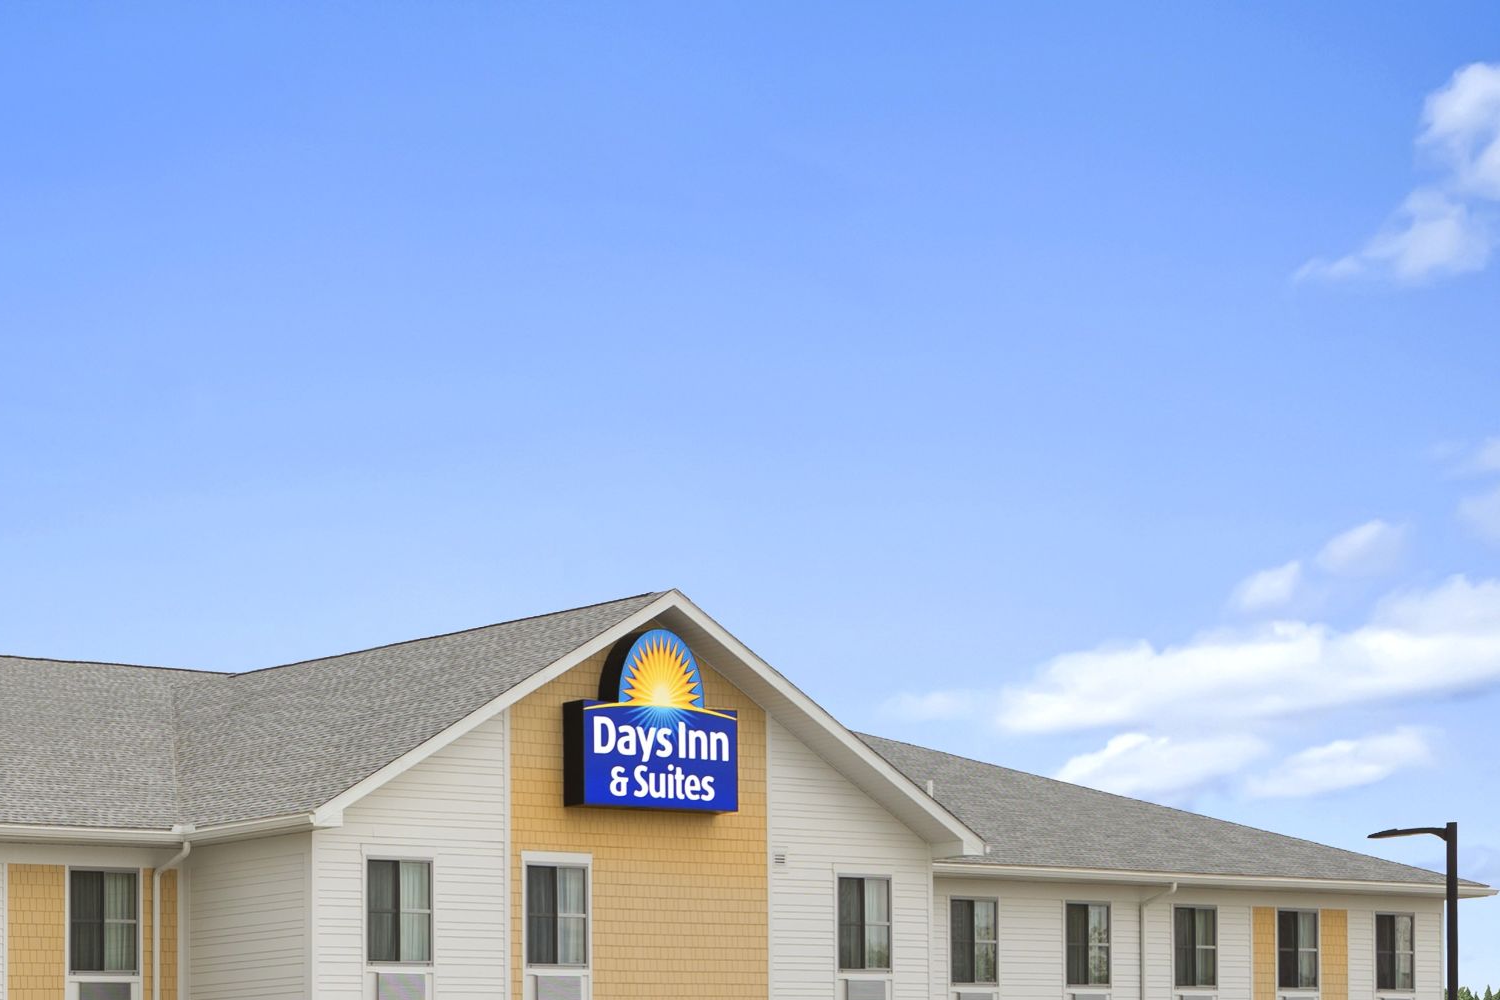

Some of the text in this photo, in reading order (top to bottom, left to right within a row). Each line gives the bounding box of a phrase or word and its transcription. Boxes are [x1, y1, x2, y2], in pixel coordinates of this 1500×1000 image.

[593, 716, 730, 762] Days Inn
[609, 764, 716, 802] & Suites
